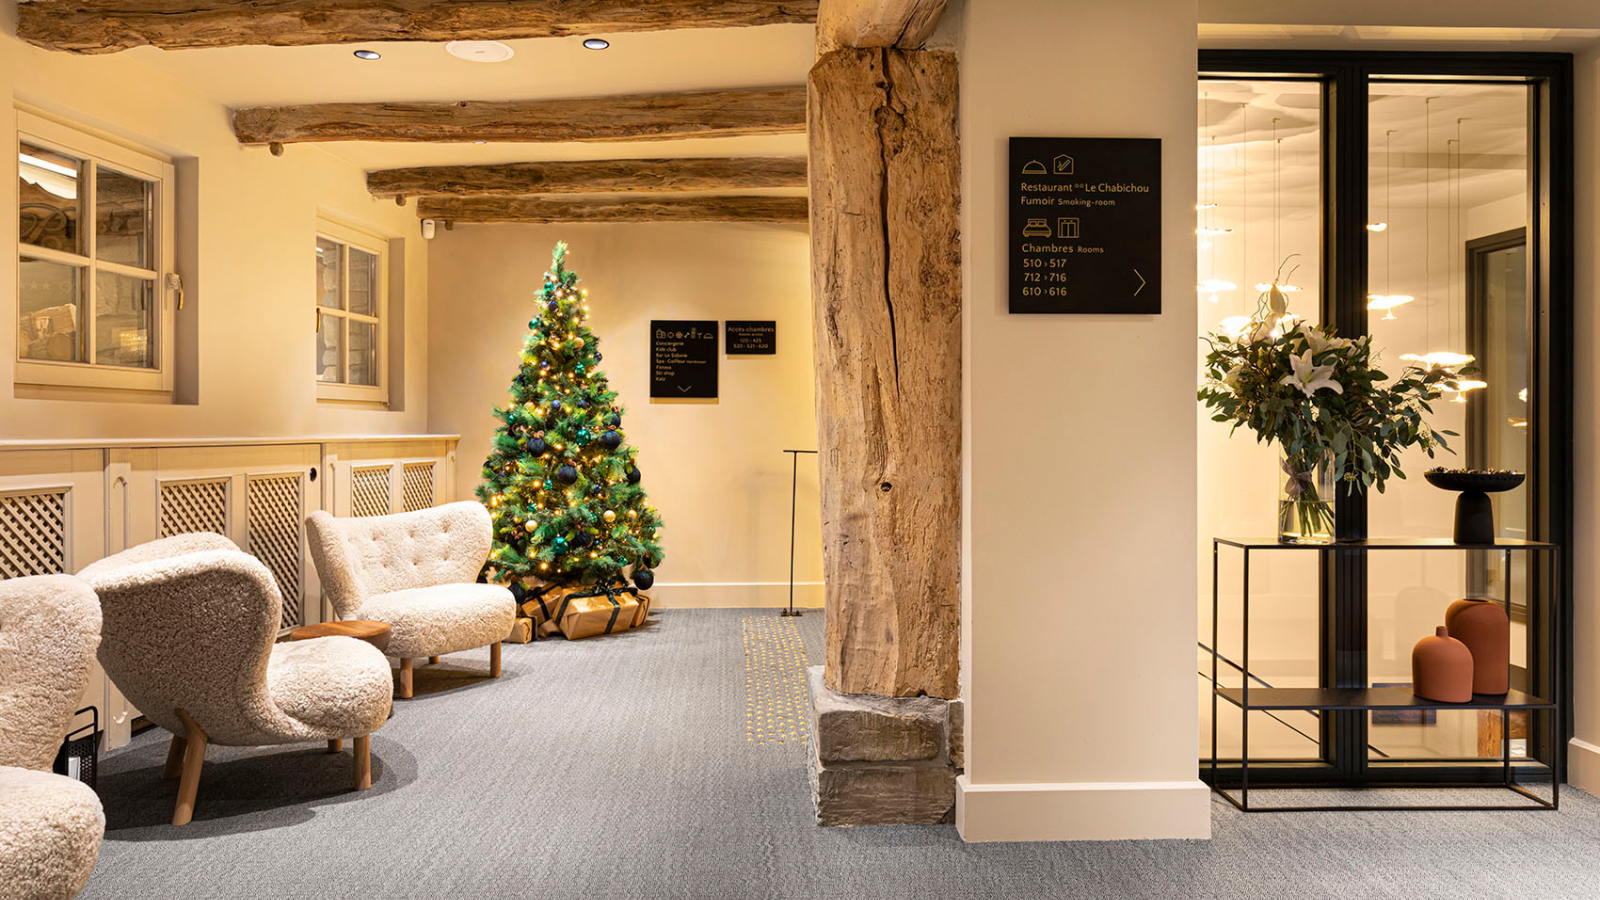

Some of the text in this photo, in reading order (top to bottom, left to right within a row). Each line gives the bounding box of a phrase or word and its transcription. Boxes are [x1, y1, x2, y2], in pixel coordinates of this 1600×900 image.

[1020, 182, 1150, 193] Restaurant Le Chabichou
[1020, 196, 1116, 208] Fumoir Smoking-room
[1021, 243, 1104, 254] Chambres Rooms
[1023, 258, 1067, 268] 510 517
[1024, 272, 1067, 282] 712 716
[1022, 286, 1067, 296] 610 616
